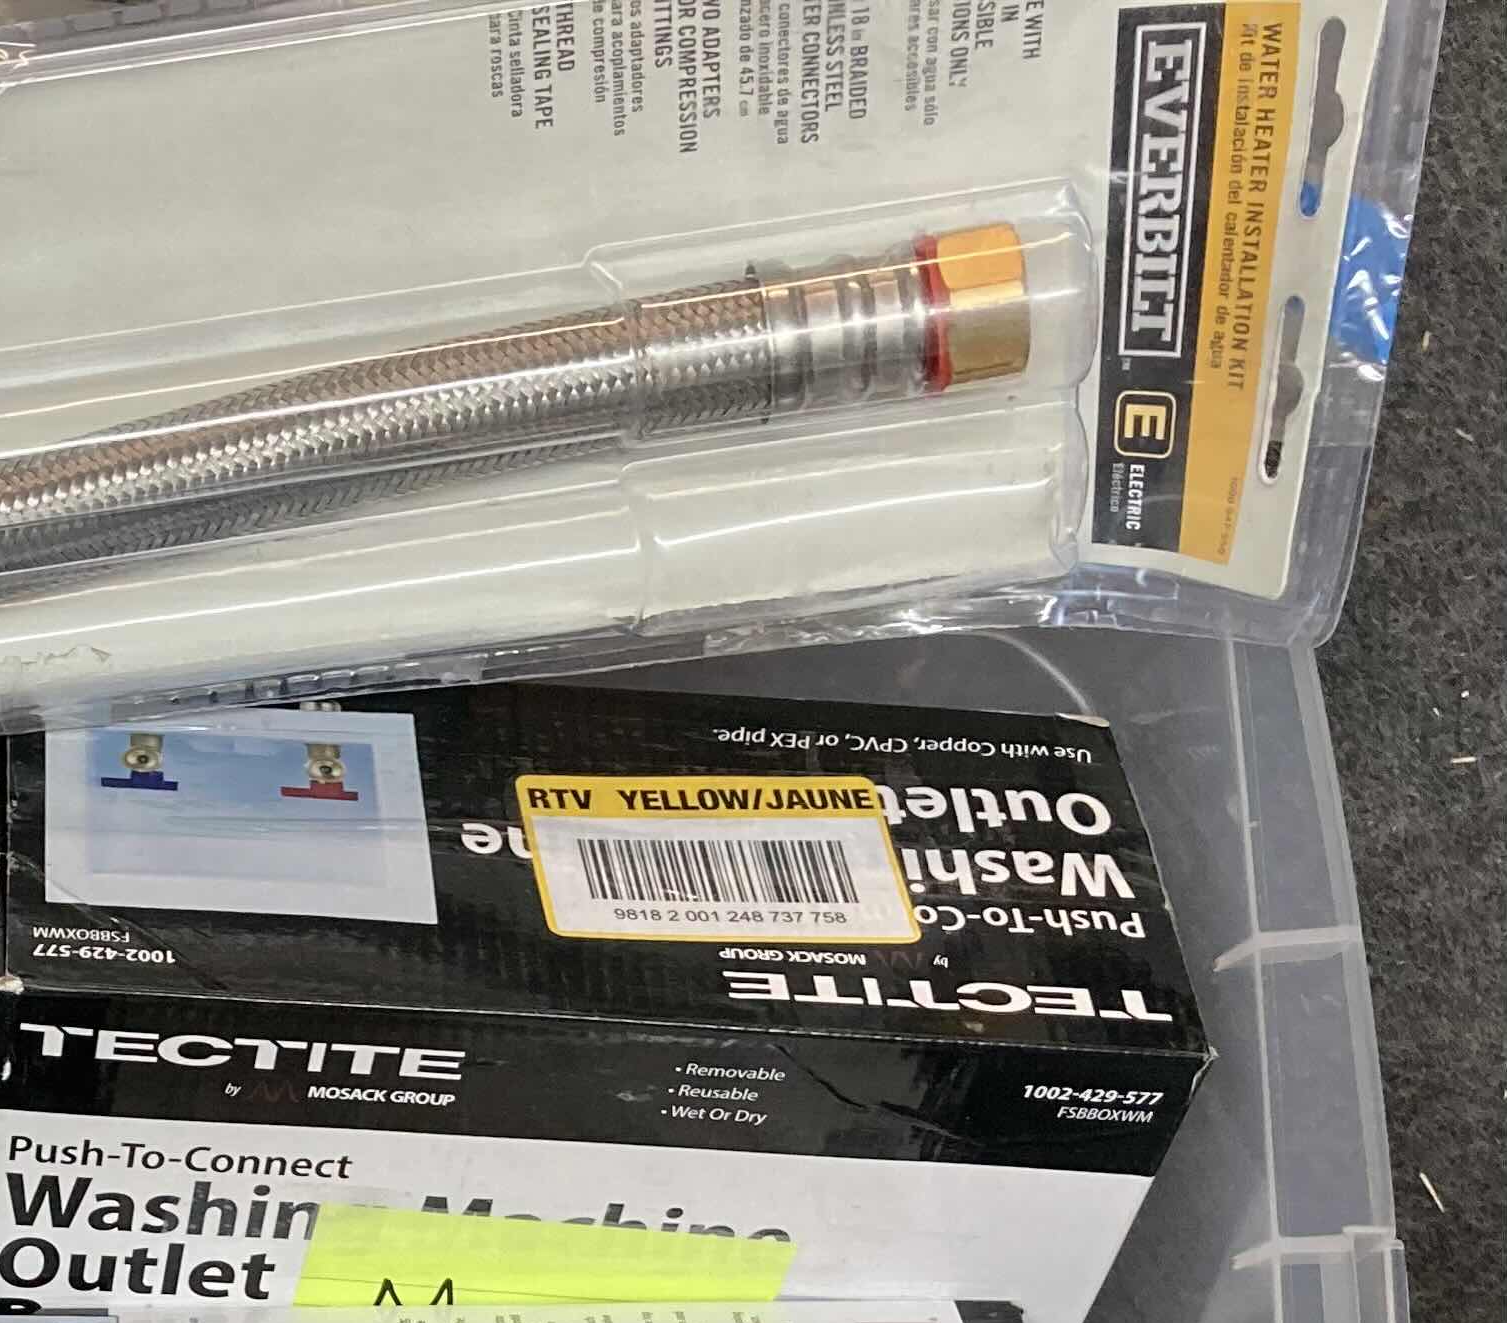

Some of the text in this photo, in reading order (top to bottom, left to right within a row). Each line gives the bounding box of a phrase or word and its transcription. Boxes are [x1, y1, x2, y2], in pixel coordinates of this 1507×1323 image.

[555, 3, 575, 72] THREAD
[1000, 5, 1019, 23] IN
[1022, 14, 1042, 60] WITH
[490, 49, 503, 98] roscas
[509, 51, 525, 118] selladora
[532, 6, 554, 129] SEALING TAPE
[590, 18, 609, 104] compresión
[609, 31, 627, 137] acoplamientos
[630, 22, 646, 113] adaptadores
[702, 26, 721, 119] ADAPTERS
[774, 3, 790, 145] conectores agua
[825, 58, 844, 112] STEEL
[849, 7, 869, 120] 18 BRAIDED
[678, 25, 698, 153] COMPRESSION
[800, 31, 821, 144] CONNECTORS
[1131, 40, 1192, 342] EVERBILT
[1216, 78, 1255, 302] instalación del calentador
[1227, 23, 1283, 391] WATER HEATER INSTALLATION KIT
[1124, 404, 1165, 441] E
[1124, 463, 1145, 531] ELECTRIC
[712, 727, 1092, 764] Use with Copper, CPVC, PEX pipe.
[528, 787, 874, 812] RTV YELLOW/JAUNE
[877, 785, 1112, 836] Outlet
[33, 925, 129, 942] FSBBOXWM
[614, 908, 847, 925] 9818 001 248 737 758
[33, 943, 175, 964] 1002-429-577
[719, 948, 866, 966] MOSACK GROUP
[722, 971, 1173, 1023] TECTITE
[20, 1022, 466, 1080] TECTITE
[685, 1063, 786, 1083] Removable
[308, 1085, 455, 1106] MOSACK GROUP
[671, 1106, 768, 1127] Wet Dry
[678, 1084, 759, 1104] Reusable
[1023, 1084, 1163, 1105] 1002-429-577
[1056, 1105, 1154, 1123] FSBBOXWM
[8, 1135, 353, 1180] Push-To-Connect
